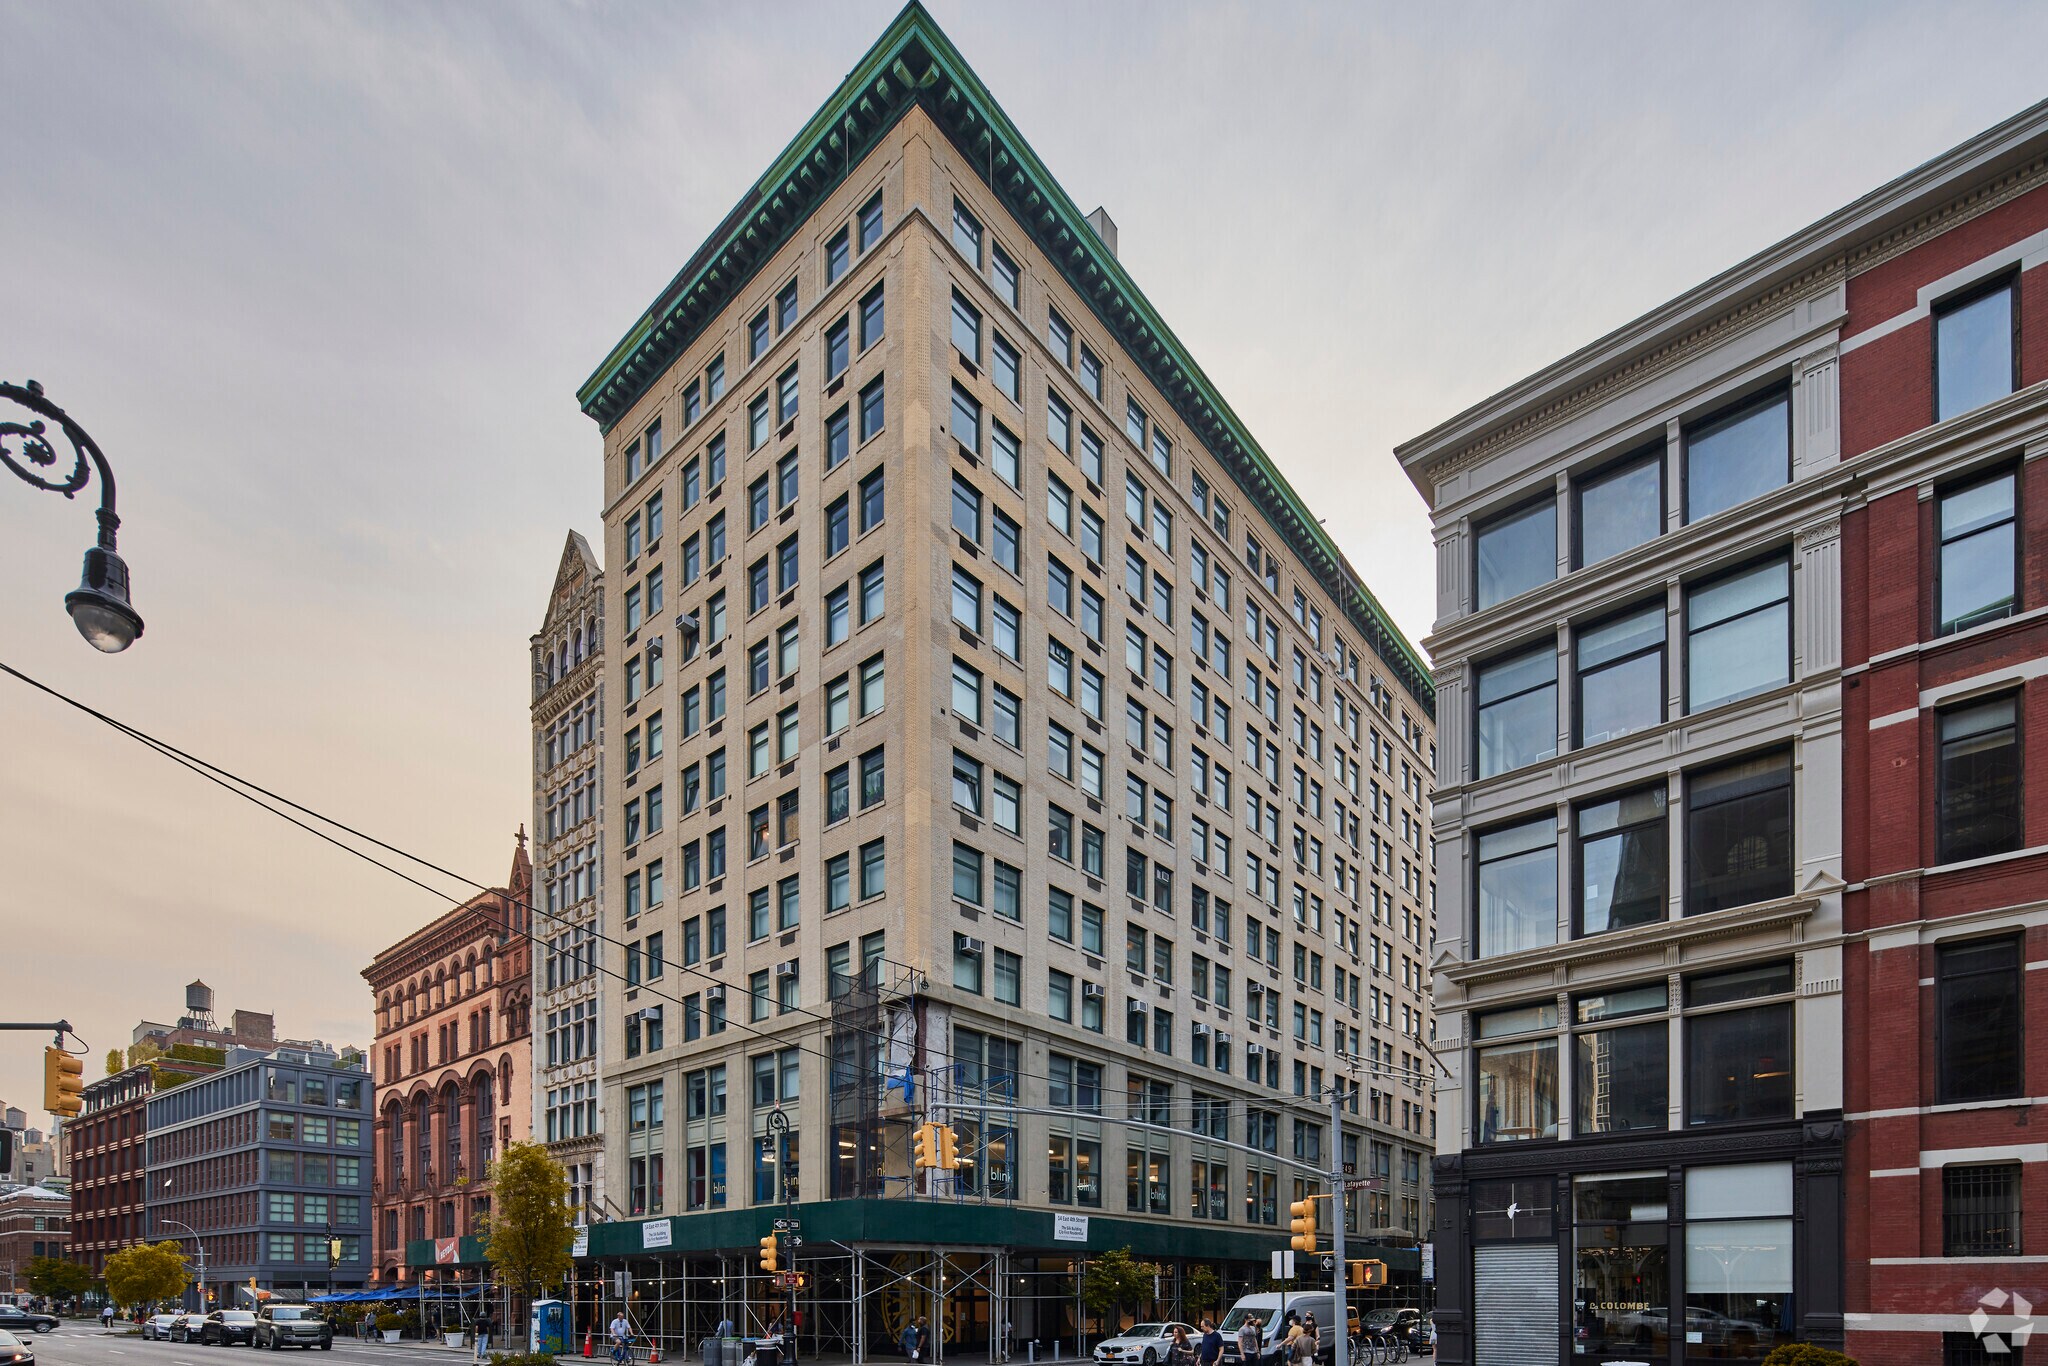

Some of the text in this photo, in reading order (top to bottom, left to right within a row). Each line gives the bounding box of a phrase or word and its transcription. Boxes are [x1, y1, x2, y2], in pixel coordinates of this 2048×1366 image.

[990, 1166, 1013, 1182] blink
[1078, 1178, 1097, 1192] blink
[1344, 1180, 1370, 1188] Lafayette
[1150, 1188, 1167, 1201] blink
[1600, 1302, 1651, 1311] COLOMBE
